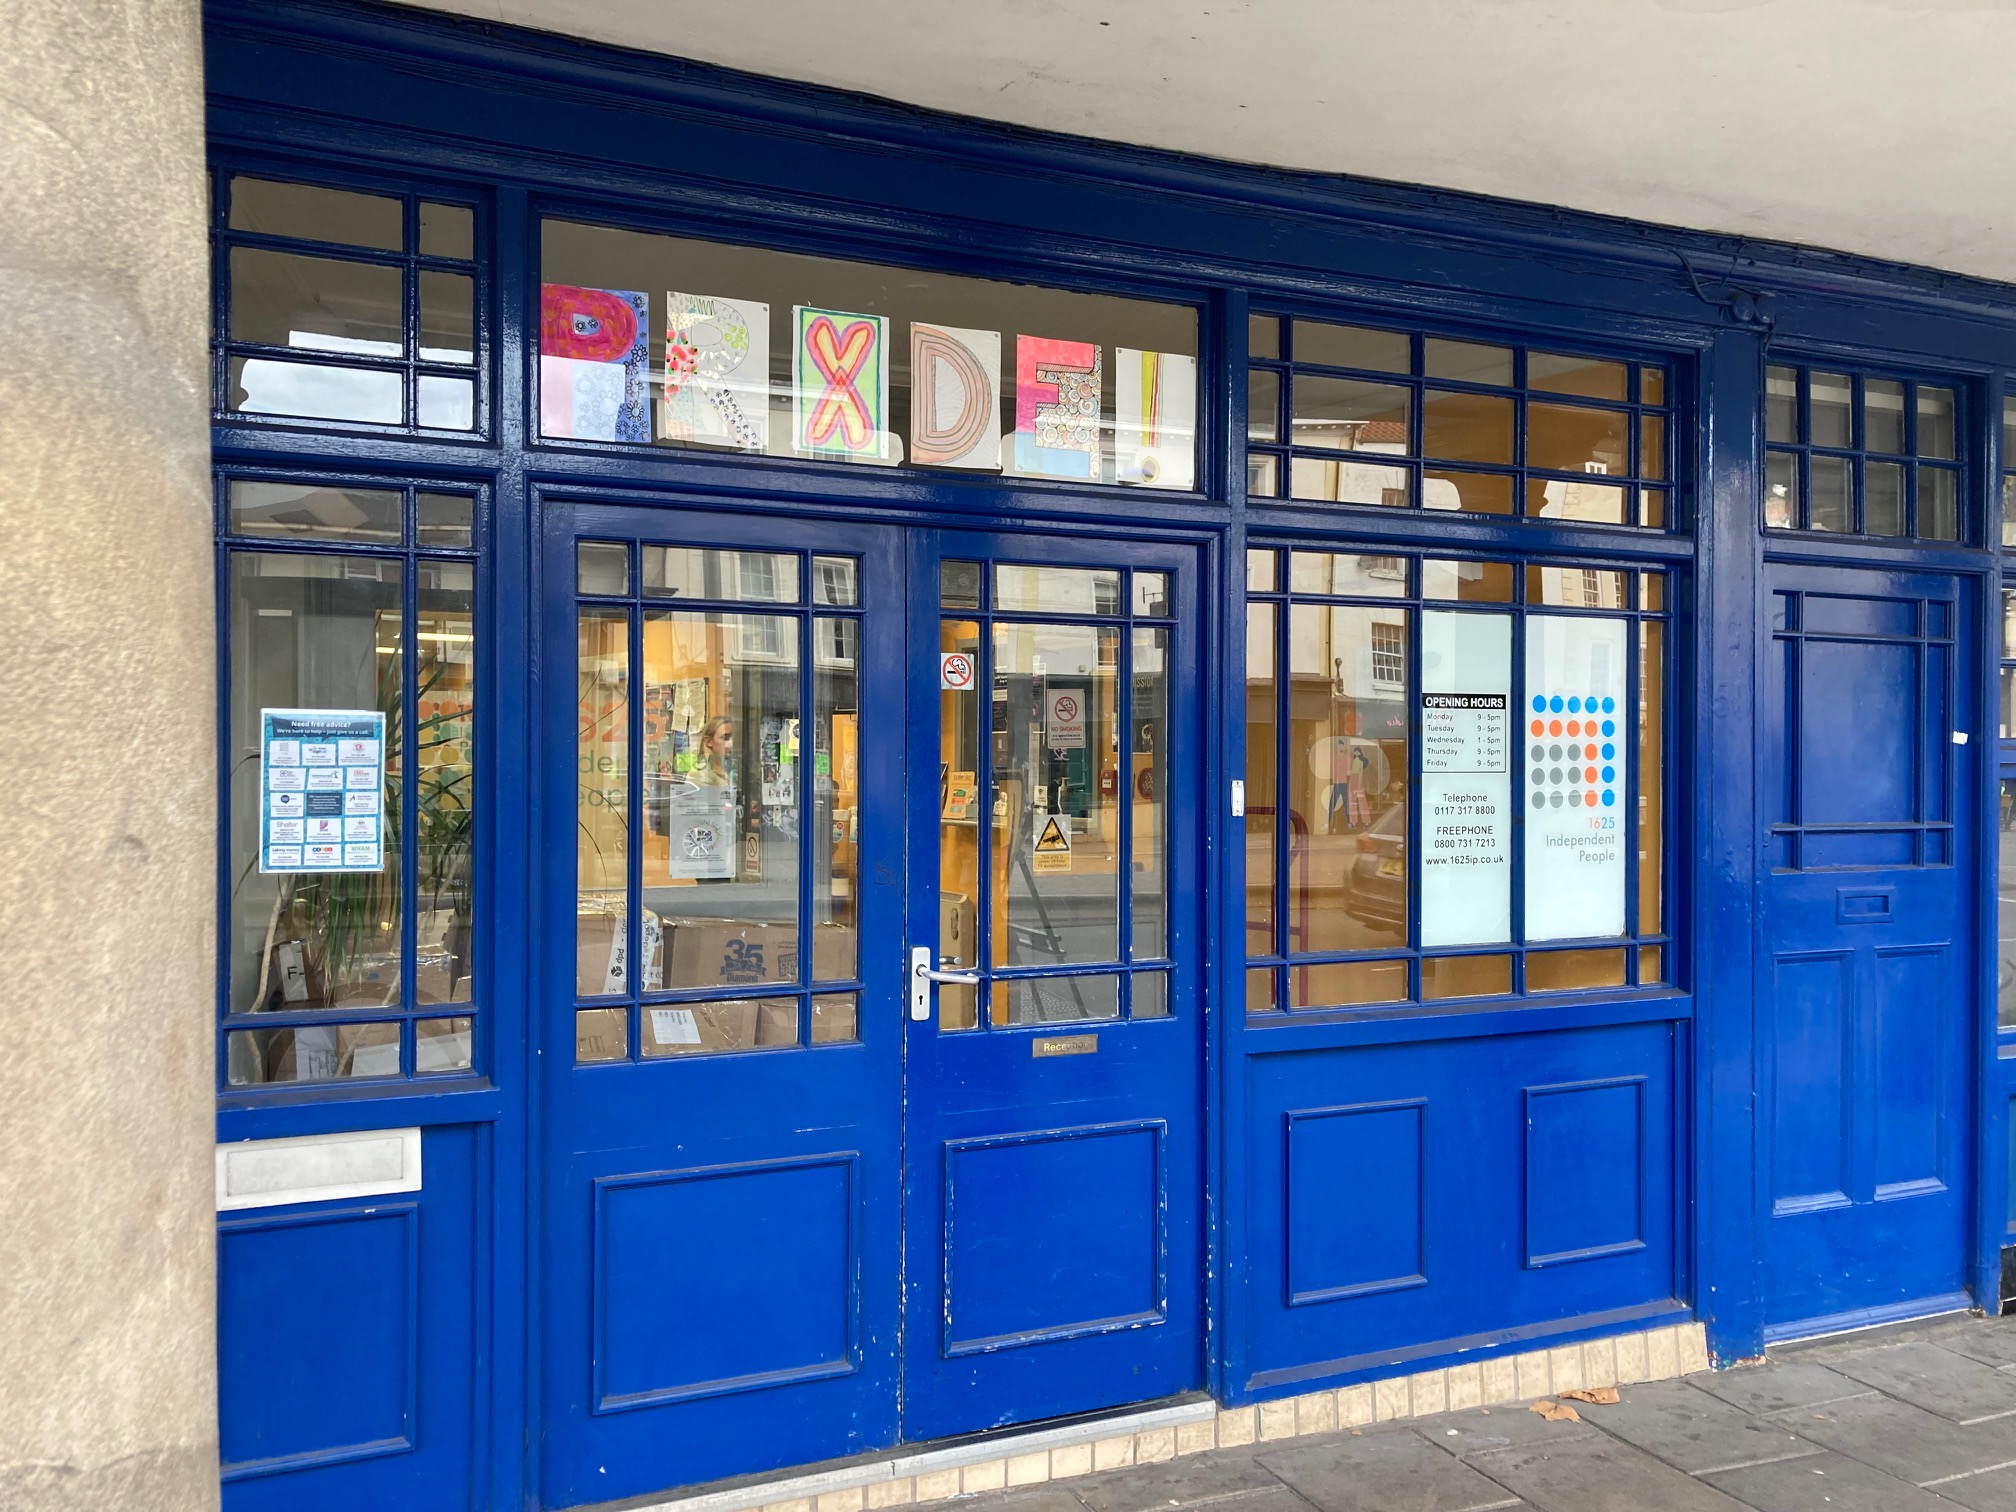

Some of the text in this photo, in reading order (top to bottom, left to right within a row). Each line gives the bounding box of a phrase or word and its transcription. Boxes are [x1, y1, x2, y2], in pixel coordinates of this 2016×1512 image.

[1425, 696, 1504, 708] OPENING HOURS
[1426, 713, 1454, 721] Monday
[1477, 713, 1482, 721] 9
[1487, 714, 1501, 722] 5pm
[291, 720, 309, 728] Need
[310, 720, 325, 728] free
[1427, 724, 1455, 733] Tuesday
[1477, 724, 1482, 732] 9
[1487, 725, 1501, 734] 5pm
[1426, 736, 1465, 744] Wednesday
[1487, 737, 1501, 745] 5pm
[1426, 747, 1458, 756] Thursday
[1487, 748, 1501, 756] 5pm
[1426, 759, 1448, 767] Friday
[1477, 759, 1482, 767] 9
[1487, 760, 1501, 768] 5pm
[1442, 793, 1488, 804] Telephone
[1434, 805, 1496, 815] 0117 317 8800
[1588, 816, 1615, 829] 1625
[1436, 825, 1494, 835] FREEPHONE
[1434, 838, 1496, 848] 0800 731 7213
[1546, 832, 1615, 849] Independent
[1425, 855, 1504, 866] www.1625ip.co.uk
[1579, 848, 1615, 864] People
[615, 948, 625, 964] dpd
[724, 938, 764, 968] 35
